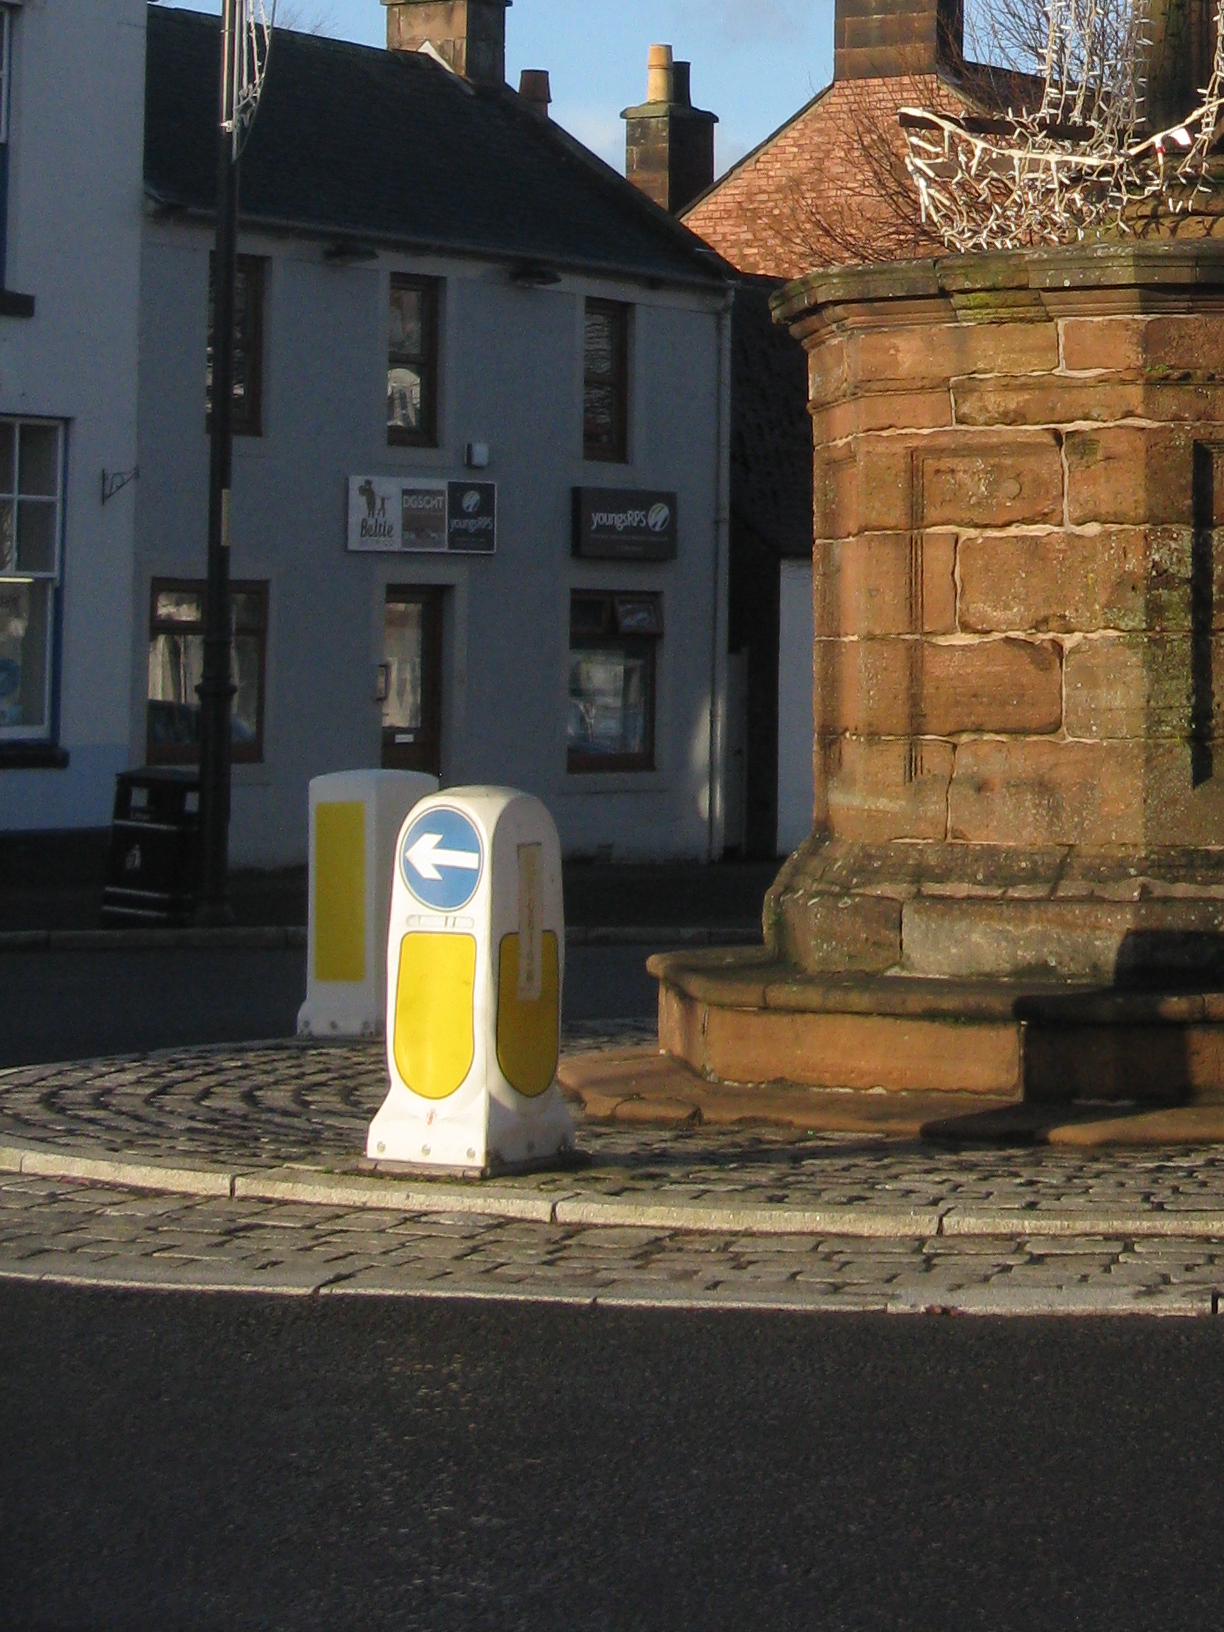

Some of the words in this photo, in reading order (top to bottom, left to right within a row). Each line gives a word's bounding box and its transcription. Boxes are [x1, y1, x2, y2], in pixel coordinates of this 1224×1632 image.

[403, 495, 445, 509] DGSCHT
[360, 517, 394, 538] Beltie
[590, 510, 647, 531] youngsRPS
